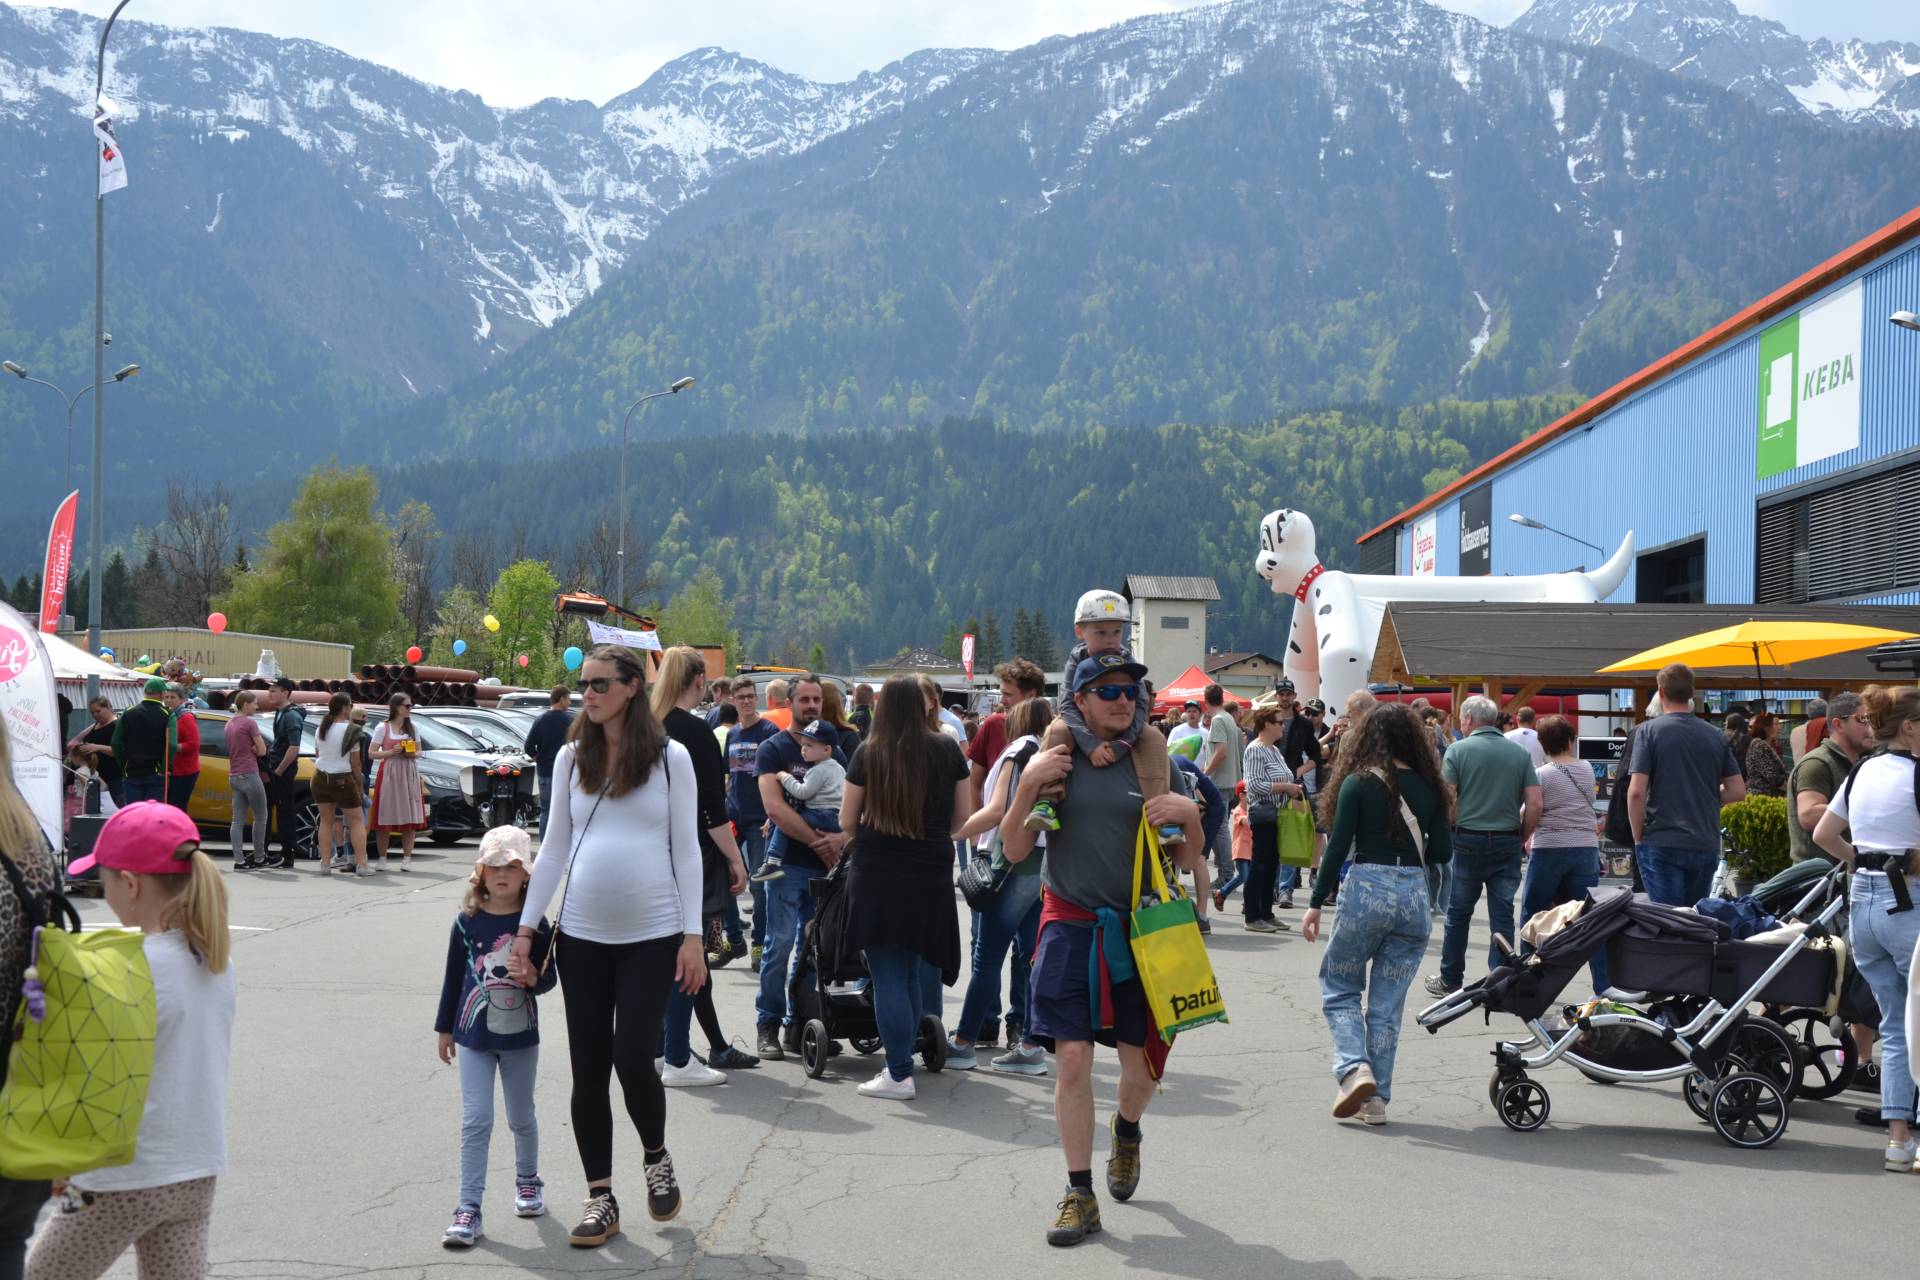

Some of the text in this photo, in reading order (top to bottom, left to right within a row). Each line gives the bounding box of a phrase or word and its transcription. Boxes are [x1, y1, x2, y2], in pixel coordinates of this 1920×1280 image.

[1803, 352, 1854, 401] KEBA
[55, 542, 66, 595] berliner
[1168, 686, 1205, 696] Milwau
